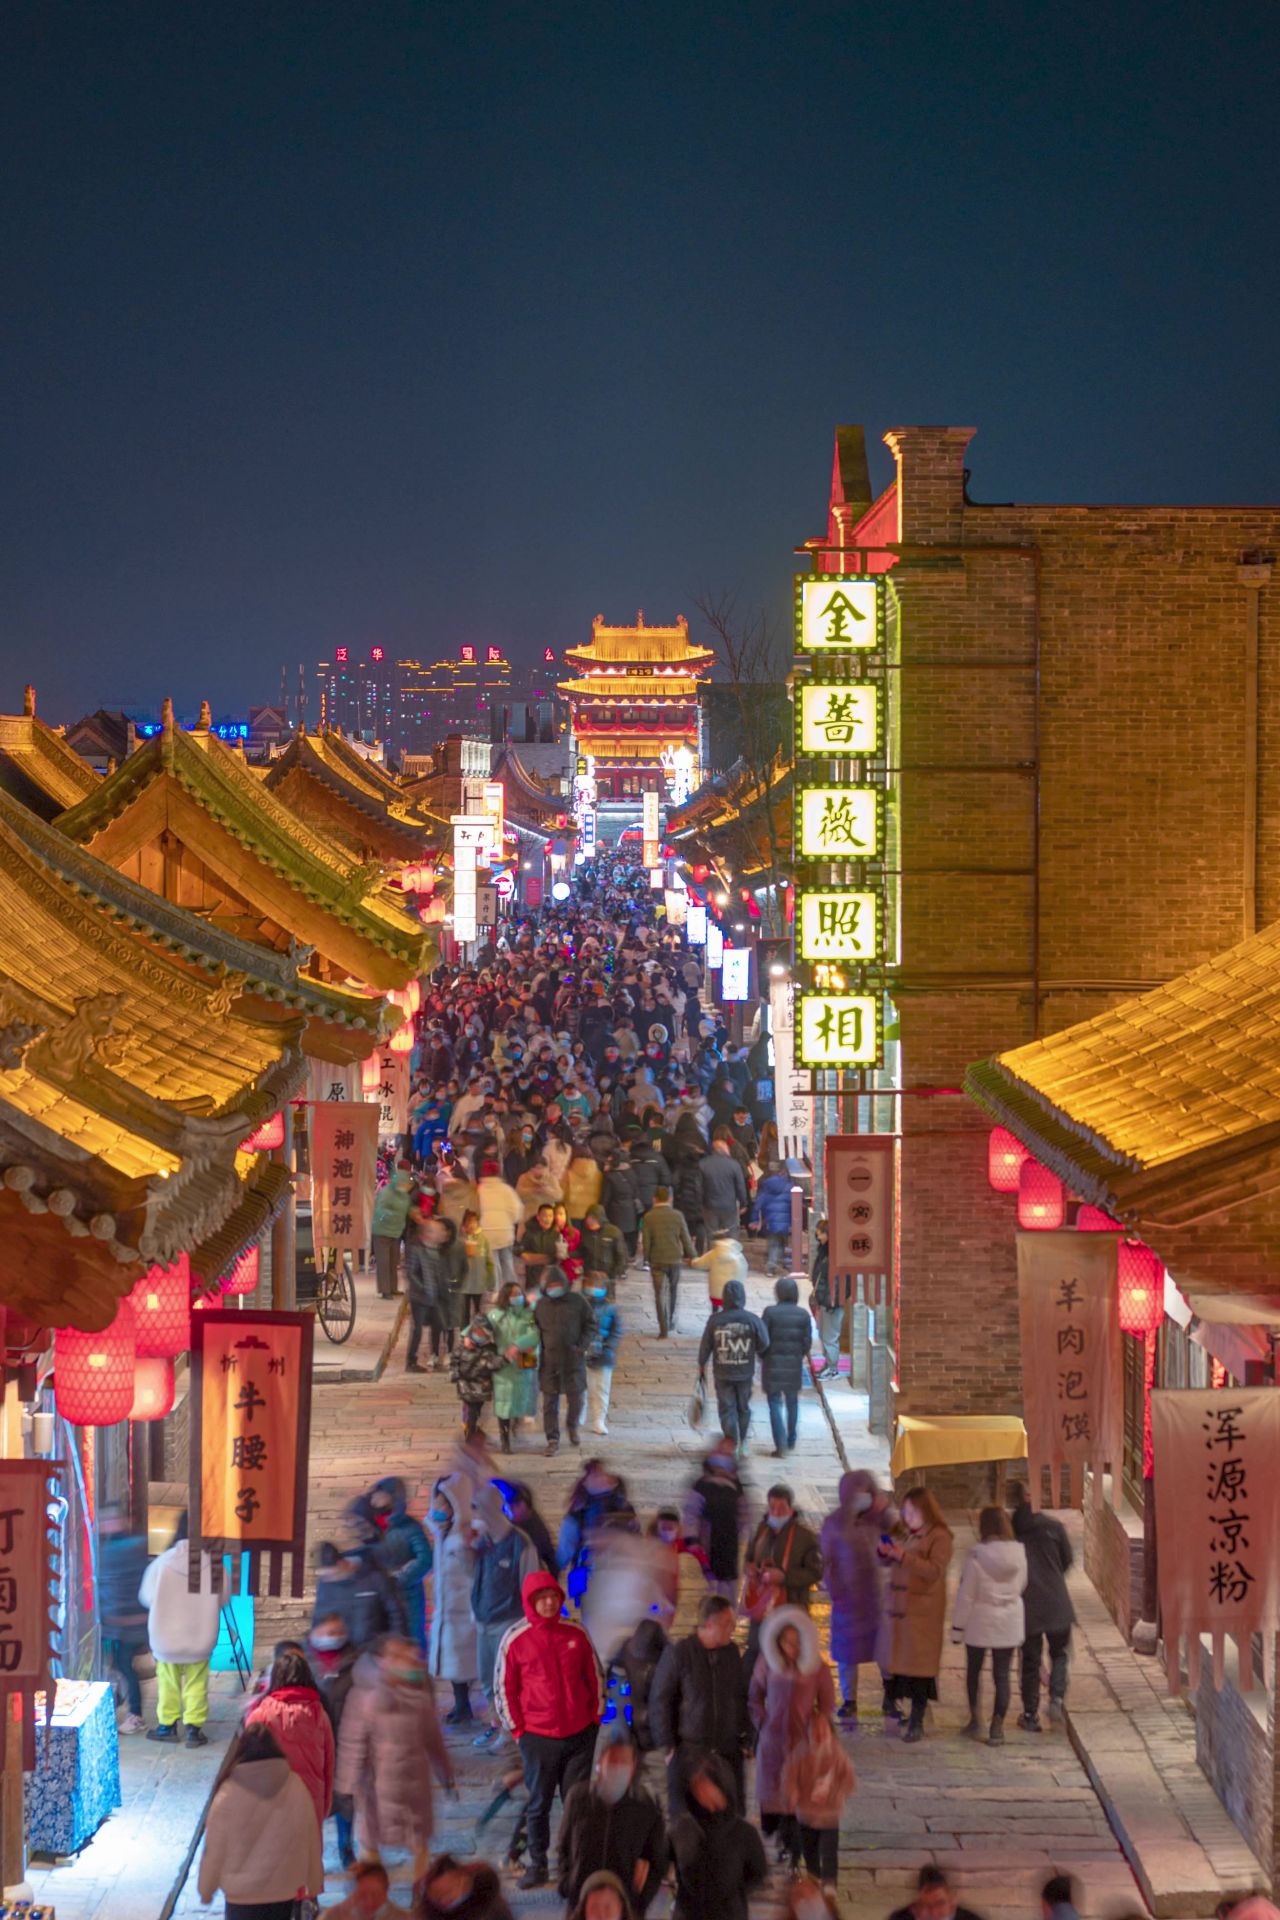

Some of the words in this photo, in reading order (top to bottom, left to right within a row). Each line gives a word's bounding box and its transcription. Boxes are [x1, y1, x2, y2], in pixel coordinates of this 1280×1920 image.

[331, 1128, 356, 1236] 神池月饼
[219, 1352, 286, 1377] 忻州
[1055, 1277, 1092, 1443] 羊肉泡馍
[230, 1380, 268, 1524] 牛腰子
